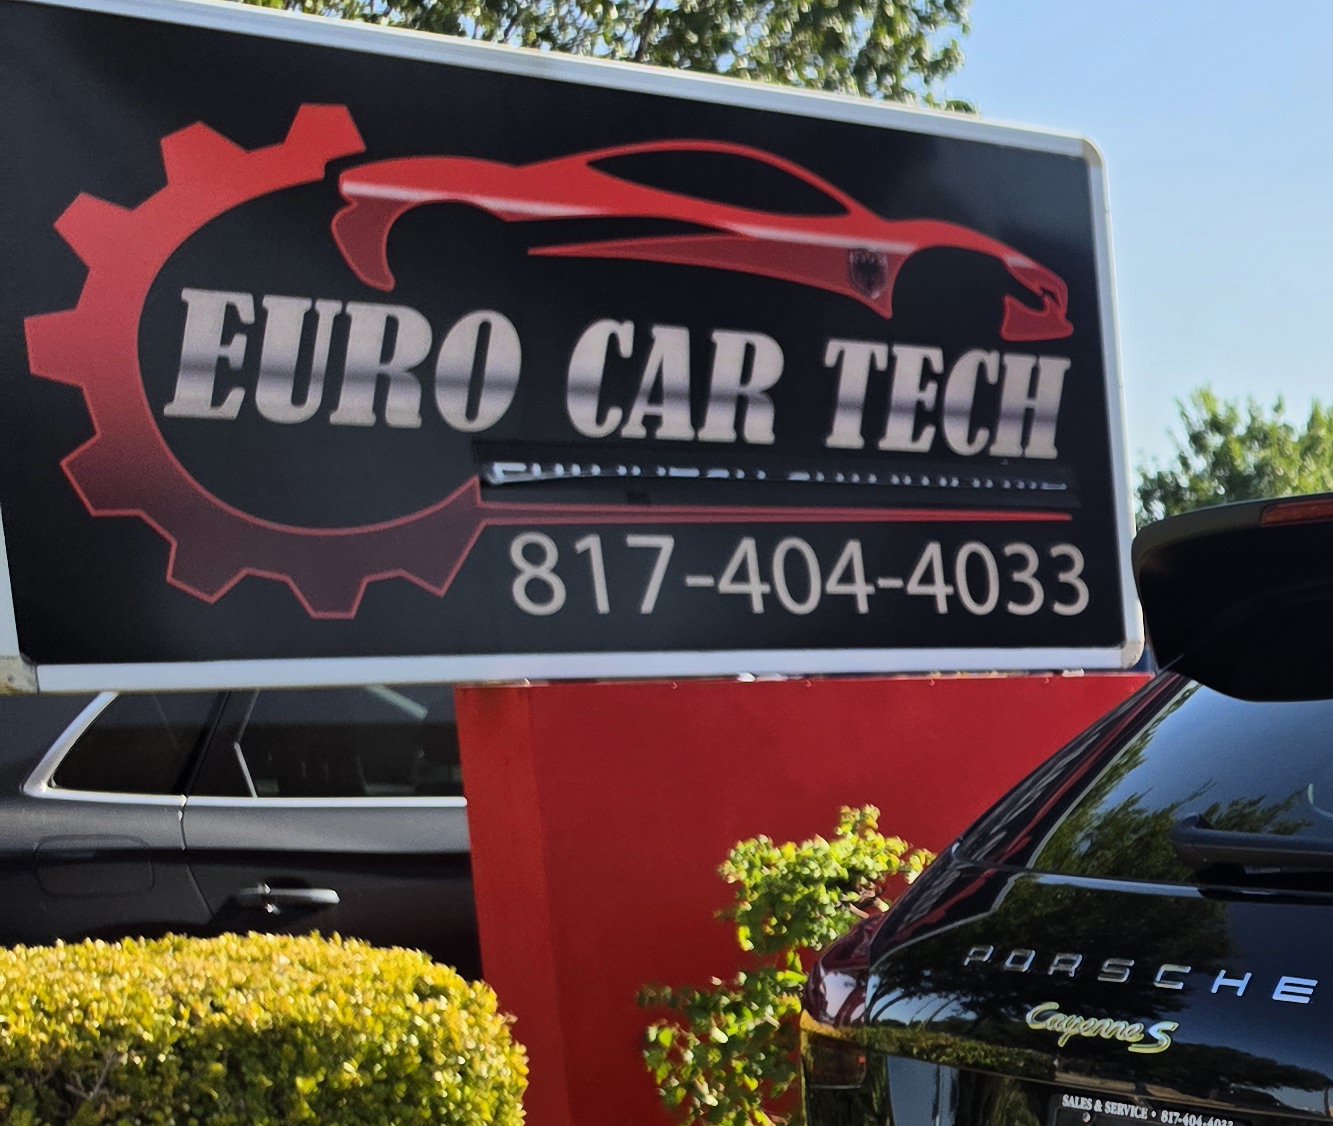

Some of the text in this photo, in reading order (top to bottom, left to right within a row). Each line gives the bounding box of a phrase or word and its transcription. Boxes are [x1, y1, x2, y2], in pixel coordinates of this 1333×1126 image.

[163, 287, 1073, 460] EURO CAR TECH
[508, 530, 1092, 617] 817-404-4033
[964, 944, 1318, 1004] PORSCHE
[1025, 1001, 1180, 1053] Cayenne S
[1062, 1094, 1093, 1111] SALES
[1093, 1100, 1103, 1113] &
[1104, 1102, 1148, 1120] SERVICE
